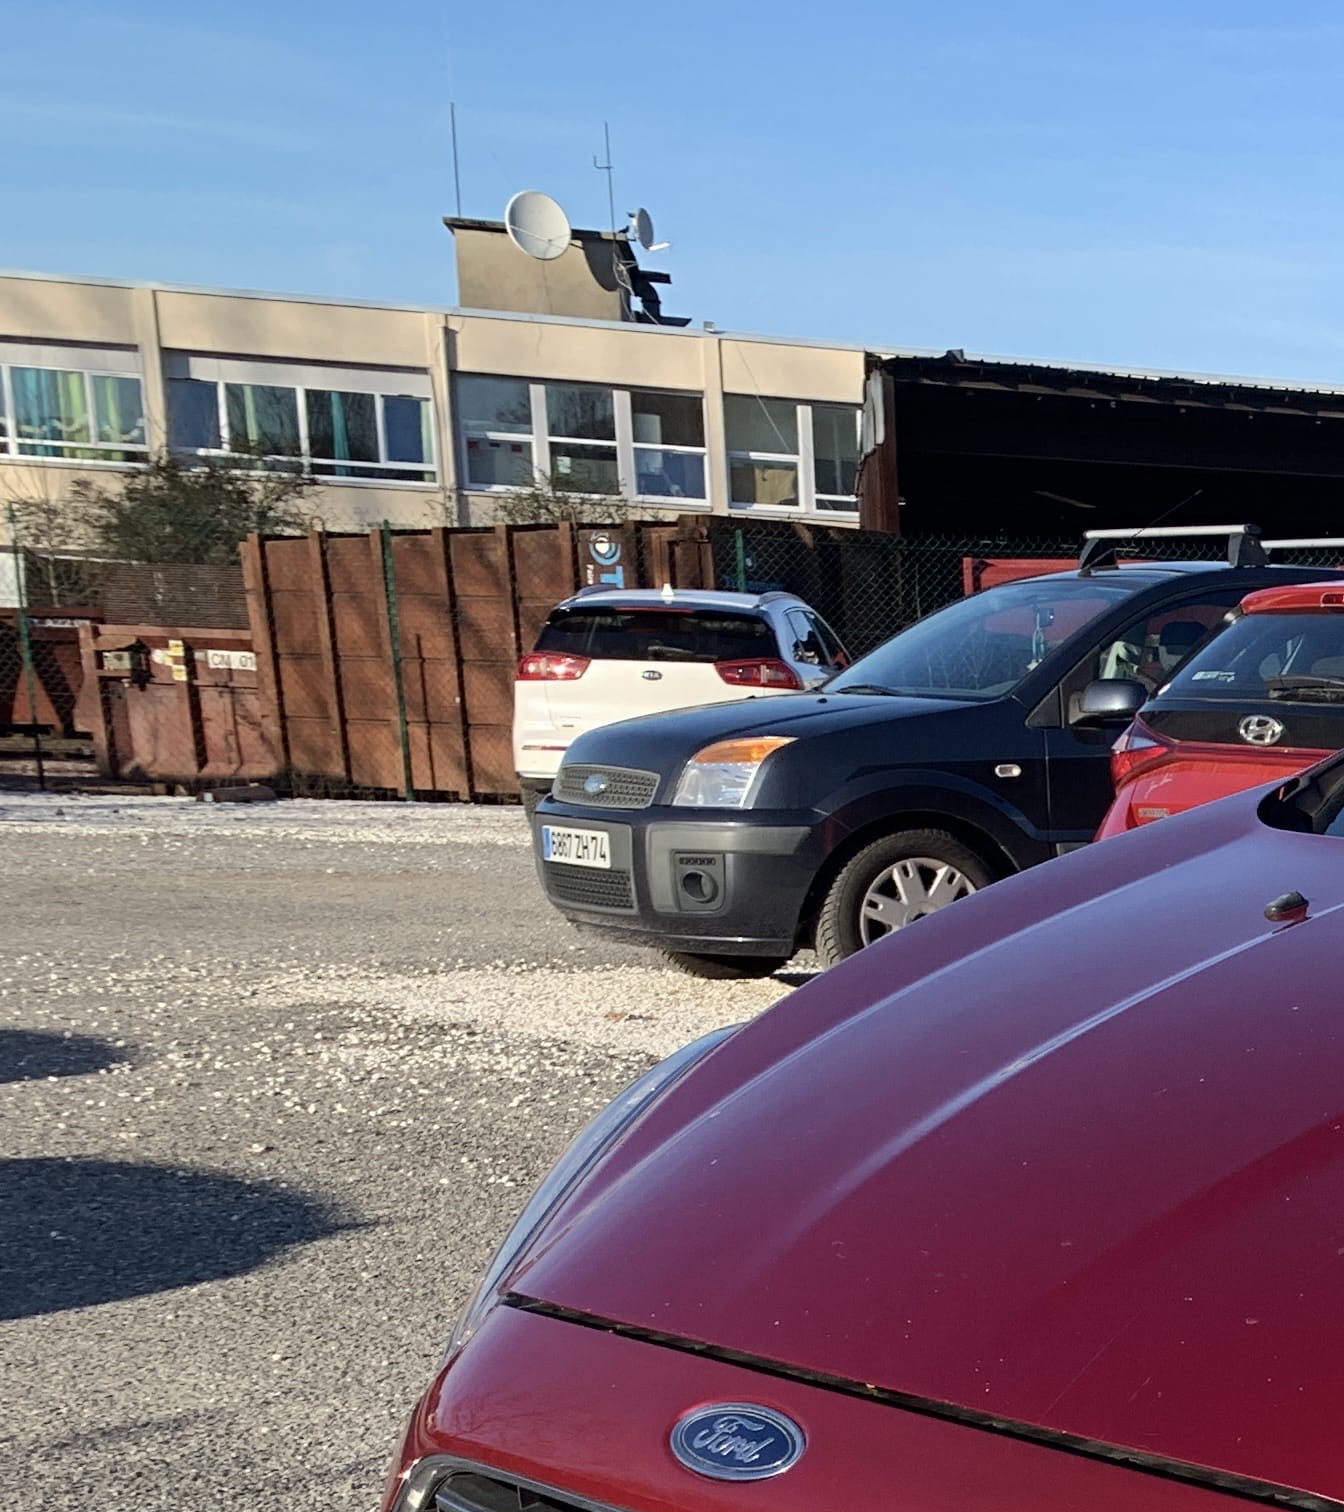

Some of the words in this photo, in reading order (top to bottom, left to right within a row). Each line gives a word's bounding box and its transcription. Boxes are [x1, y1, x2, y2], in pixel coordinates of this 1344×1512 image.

[574, 834, 590, 860] ZH
[591, 836, 606, 862] 74
[692, 1415, 775, 1463] Ford
